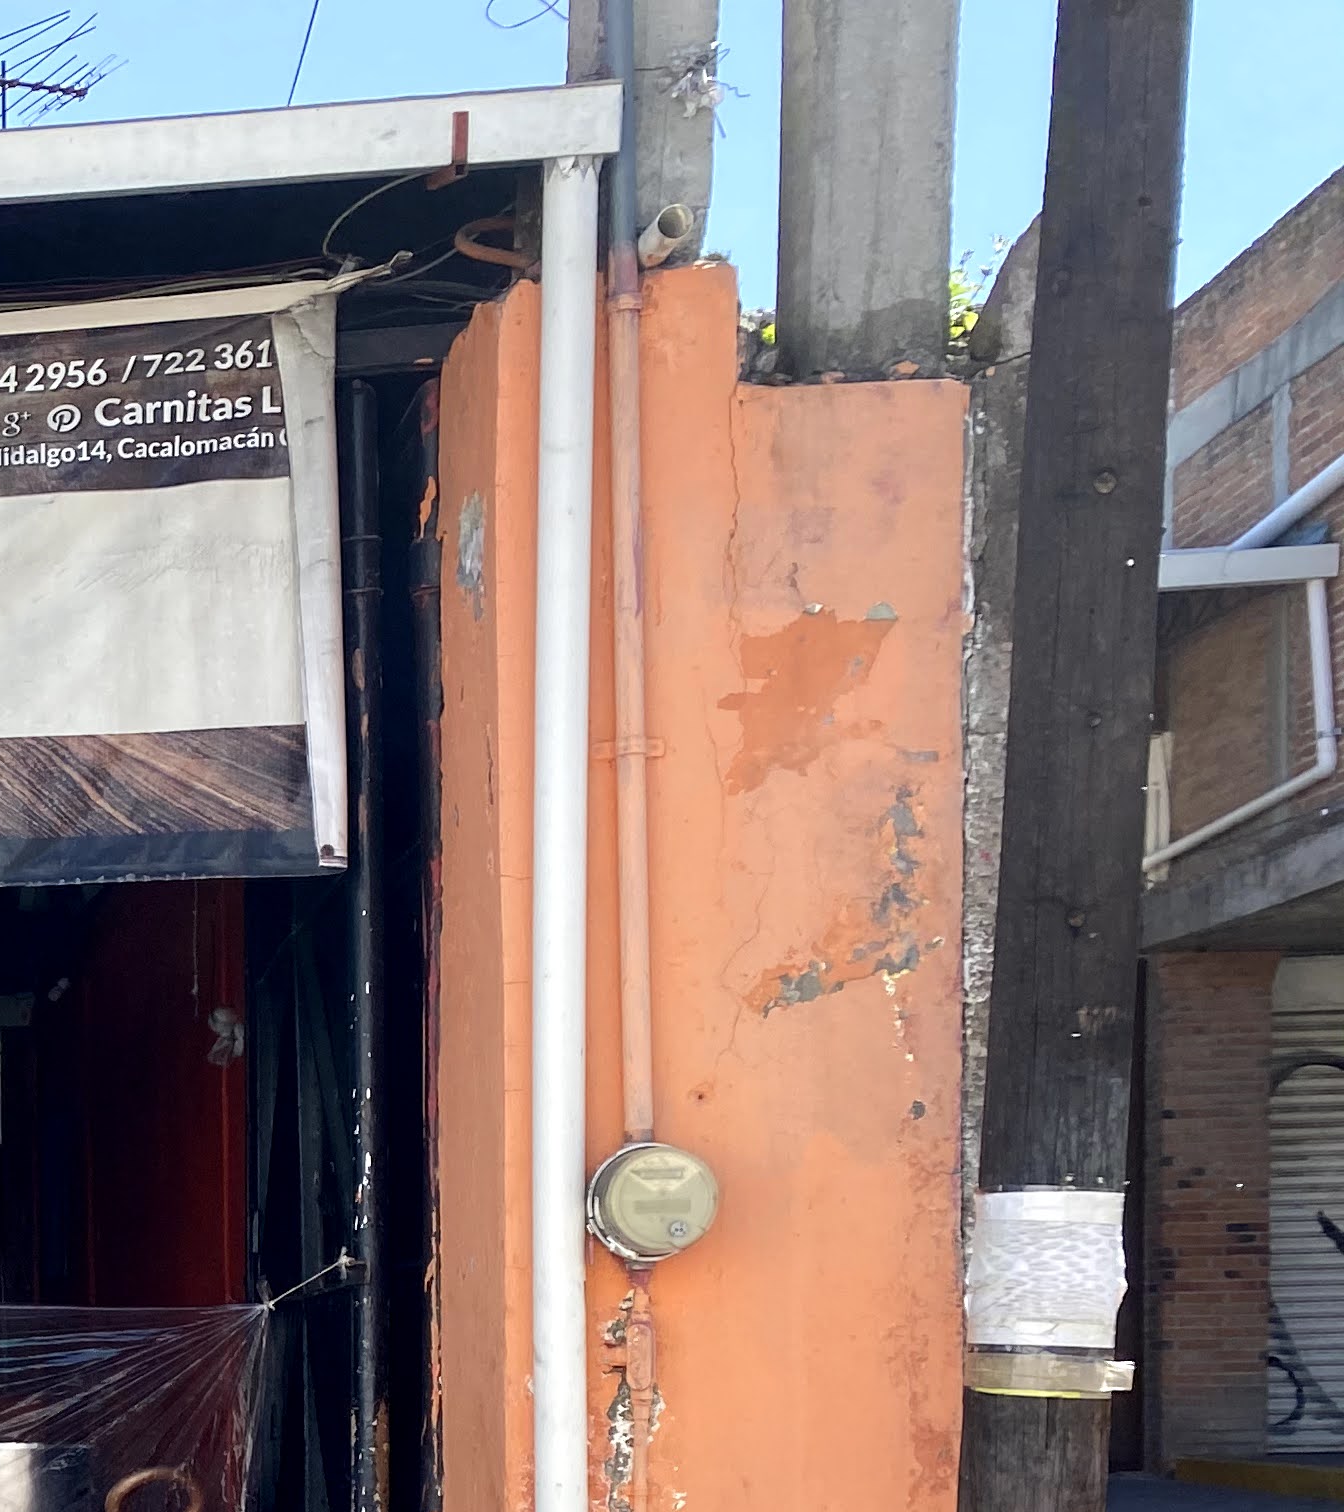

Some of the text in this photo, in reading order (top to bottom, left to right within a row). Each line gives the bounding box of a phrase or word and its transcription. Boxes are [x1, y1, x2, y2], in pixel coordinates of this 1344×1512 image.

[25, 358, 108, 392] 2956
[143, 349, 206, 378] 722
[214, 339, 273, 371] 361
[95, 389, 252, 427] Carnitas
[118, 427, 274, 459] Cacalomacán
